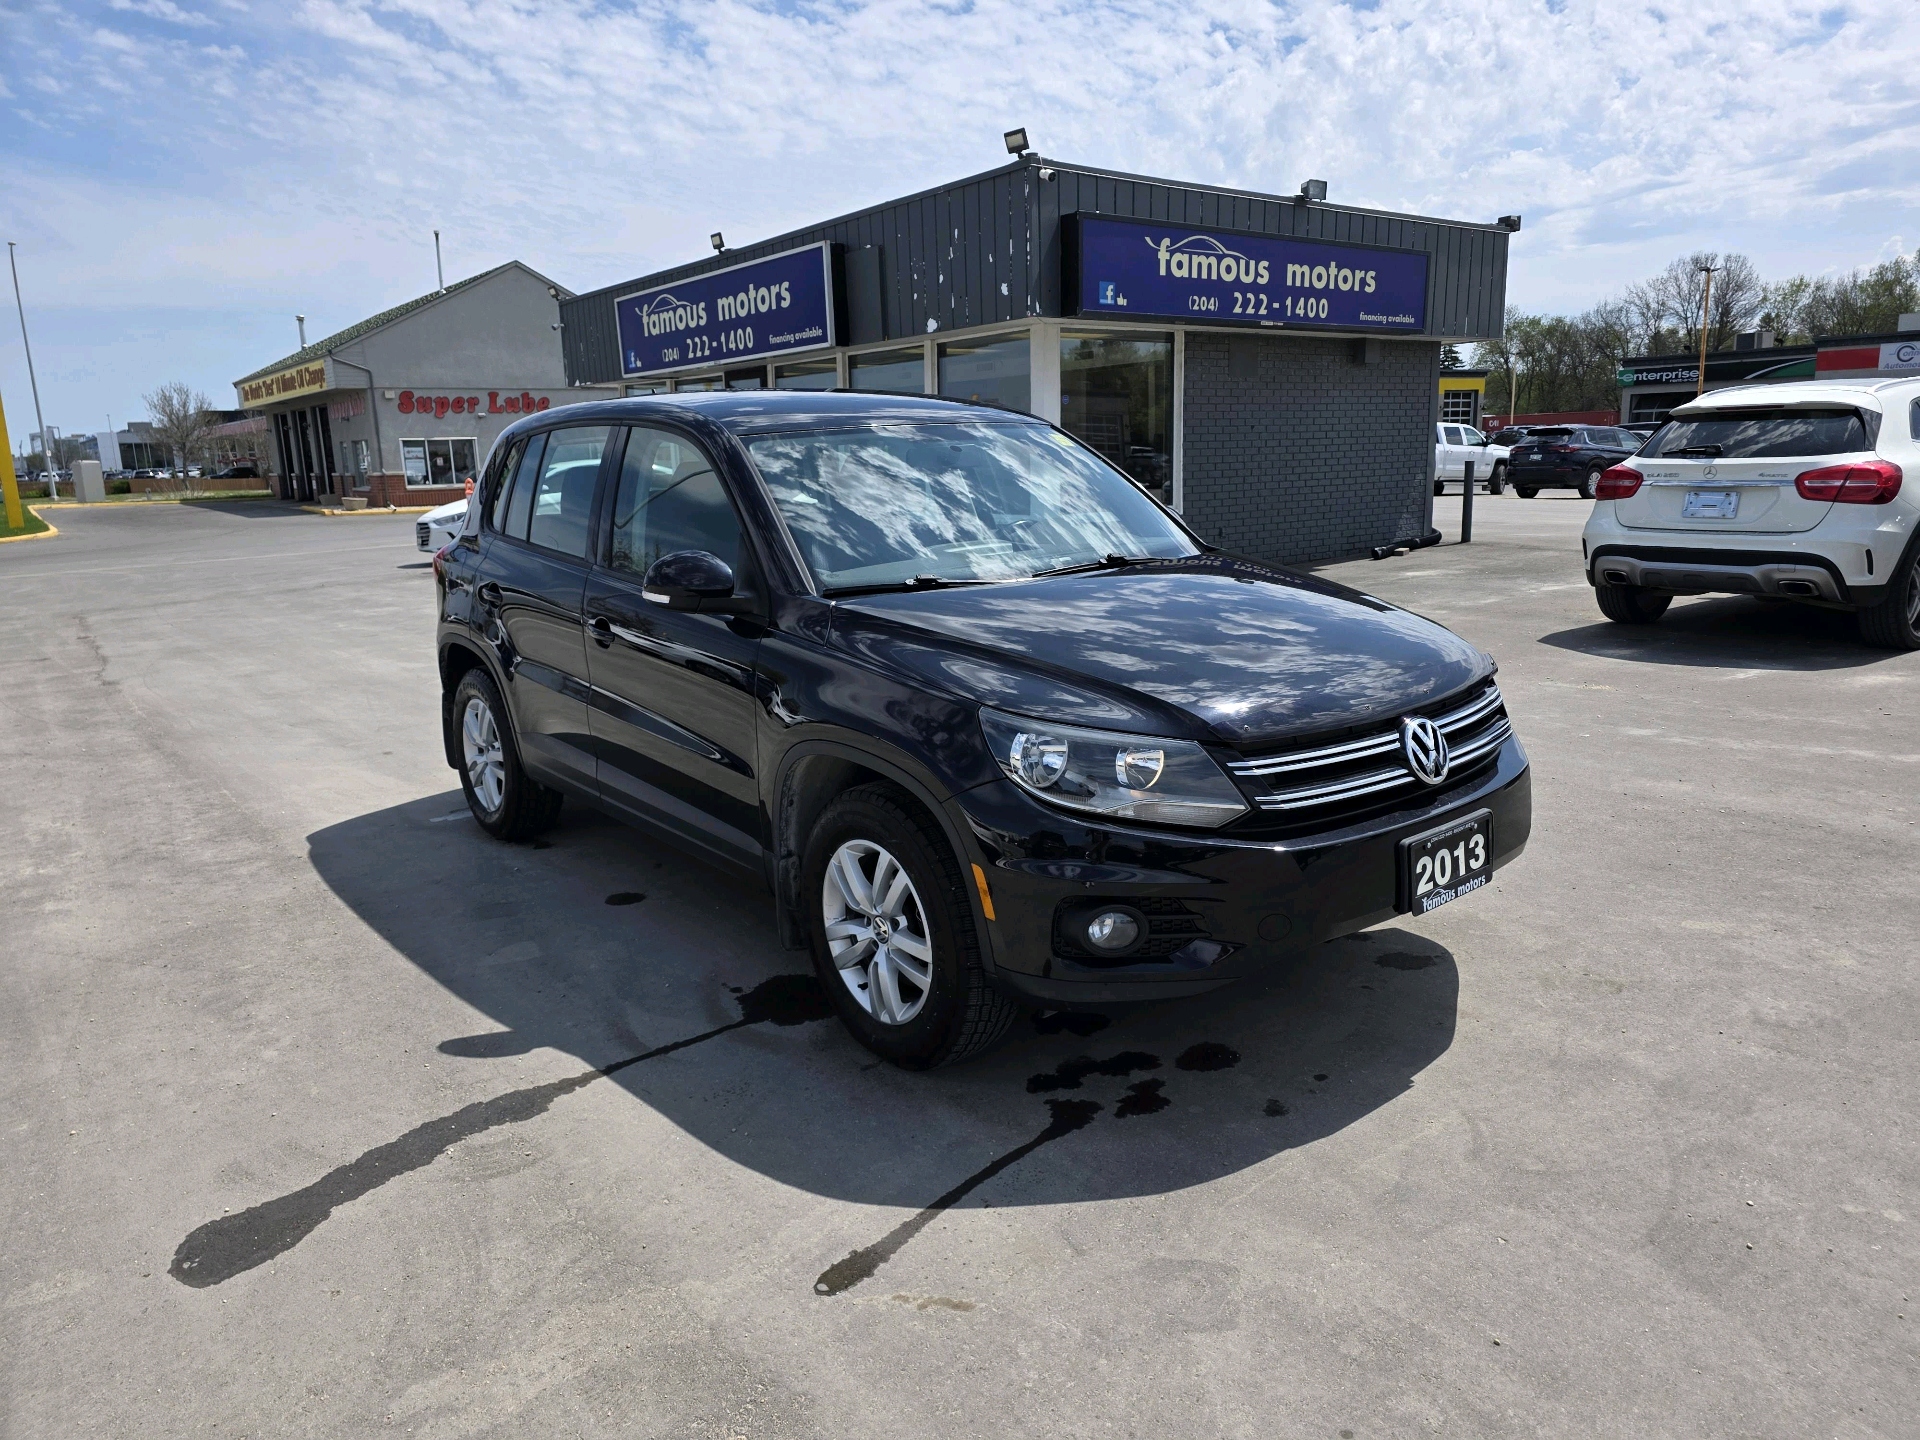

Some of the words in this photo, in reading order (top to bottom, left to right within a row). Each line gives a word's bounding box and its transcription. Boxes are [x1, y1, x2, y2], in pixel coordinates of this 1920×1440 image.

[1158, 237, 1269, 285] famous
[1286, 261, 1376, 293] motors
[642, 302, 707, 337] famous
[717, 281, 791, 321] motors
[1189, 295, 1218, 312] (204)
[1360, 311, 1387, 324] financing
[1388, 314, 1415, 324] available
[769, 332, 795, 344] financing
[795, 326, 823, 340] available
[662, 347, 680, 362] (204)
[296, 369, 304, 389] Oil
[304, 366, 325, 389] Change
[1619, 368, 1699, 382] enterprise
[398, 390, 480, 418] Super
[487, 391, 550, 414] Lube
[1415, 833, 1486, 896] 2013
[1423, 888, 1455, 912] famous
[1457, 875, 1486, 897] motors
